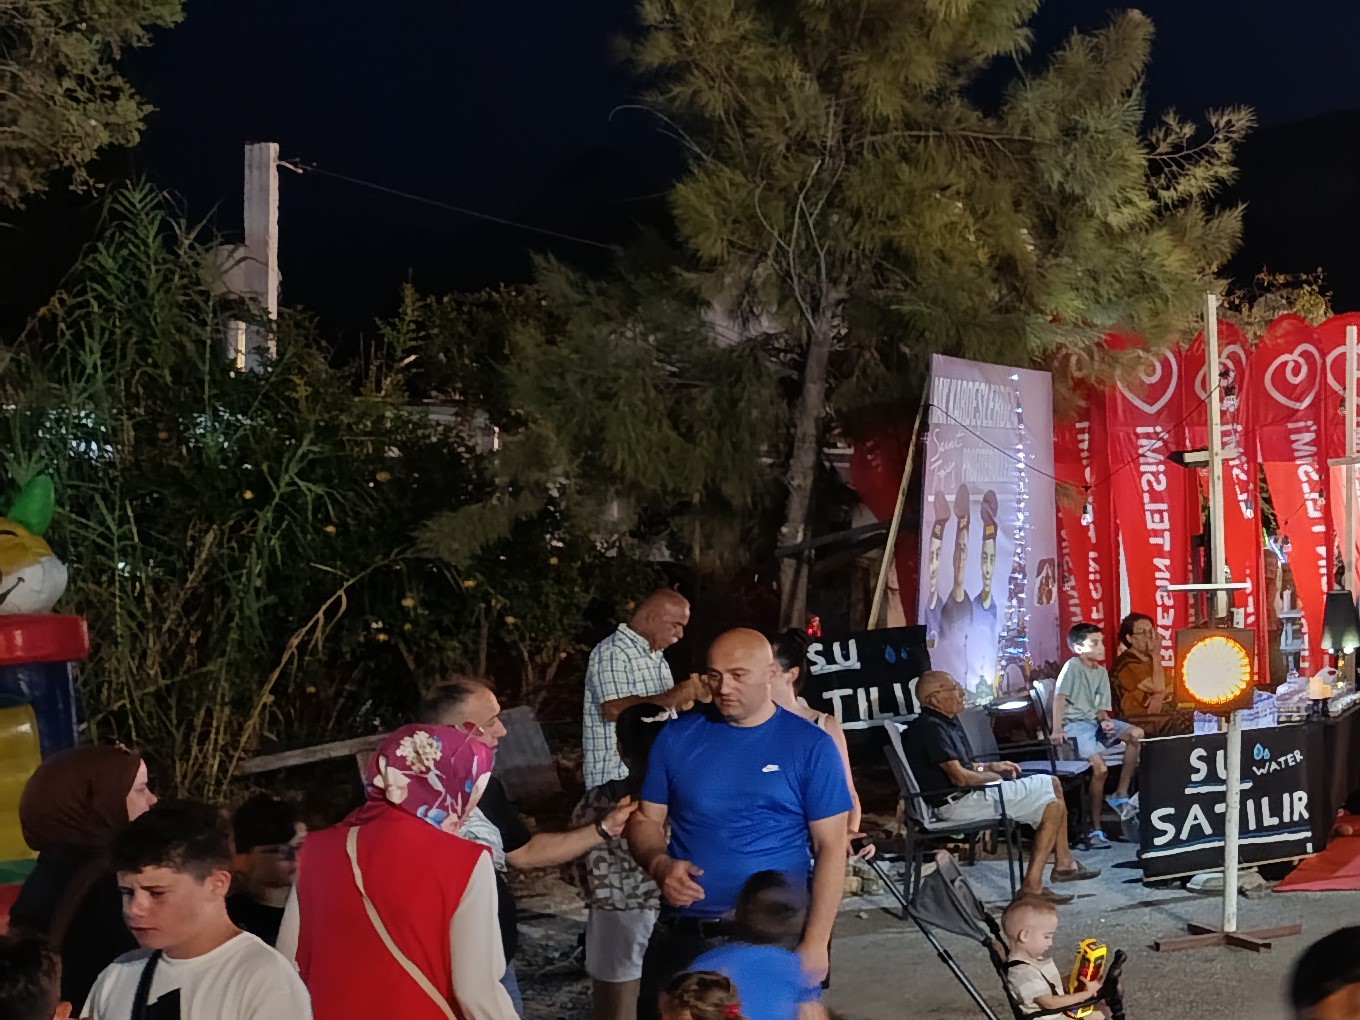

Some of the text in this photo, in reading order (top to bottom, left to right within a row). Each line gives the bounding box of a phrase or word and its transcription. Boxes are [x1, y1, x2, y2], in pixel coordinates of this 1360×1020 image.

[806, 639, 858, 668] SU
[822, 677, 922, 725] TILI
[1252, 749, 1304, 776] WATER
